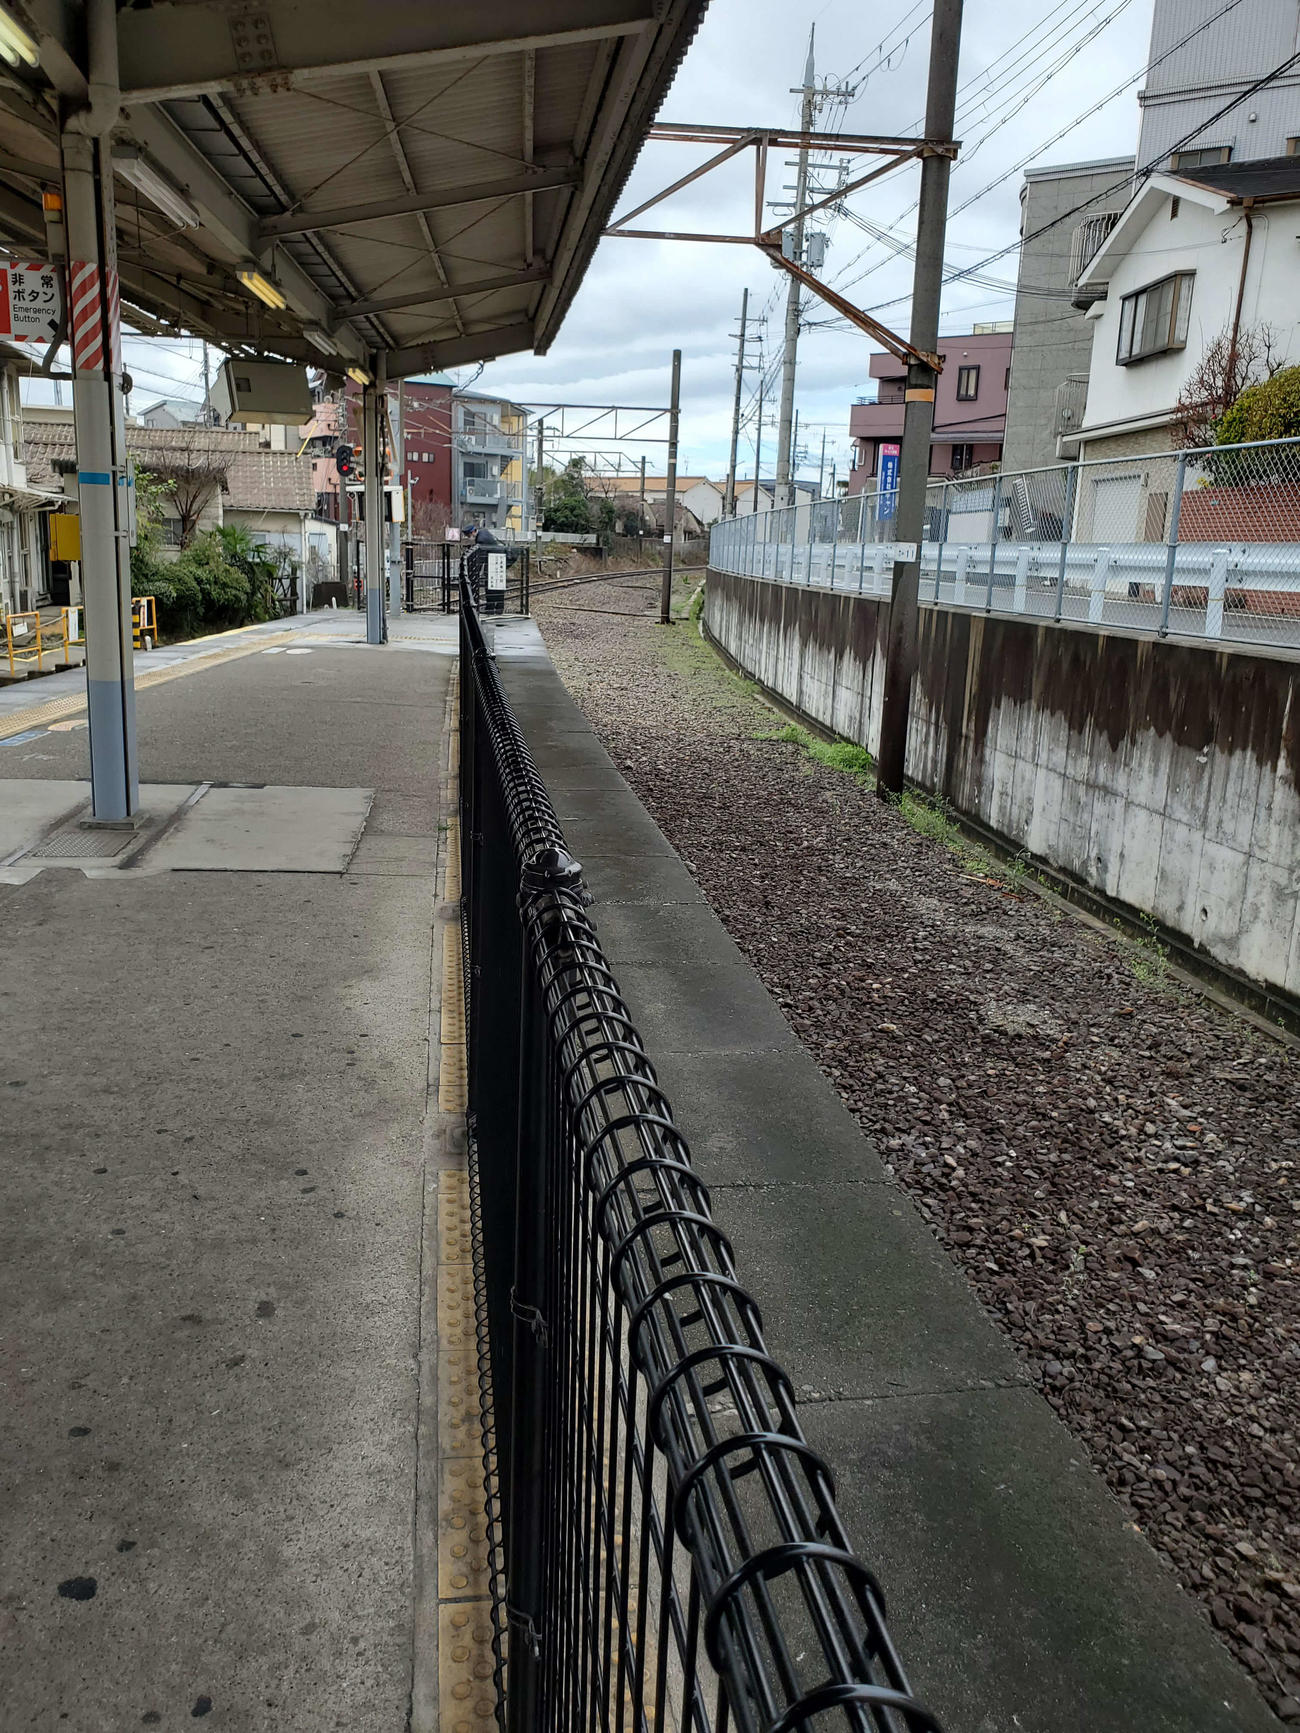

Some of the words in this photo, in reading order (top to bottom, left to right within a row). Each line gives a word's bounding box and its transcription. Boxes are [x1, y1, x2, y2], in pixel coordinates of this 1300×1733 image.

[11, 273, 54, 288] 非常
[13, 288, 55, 303] ボタン
[13, 304, 56, 316] Emergency
[13, 314, 40, 323] Button
